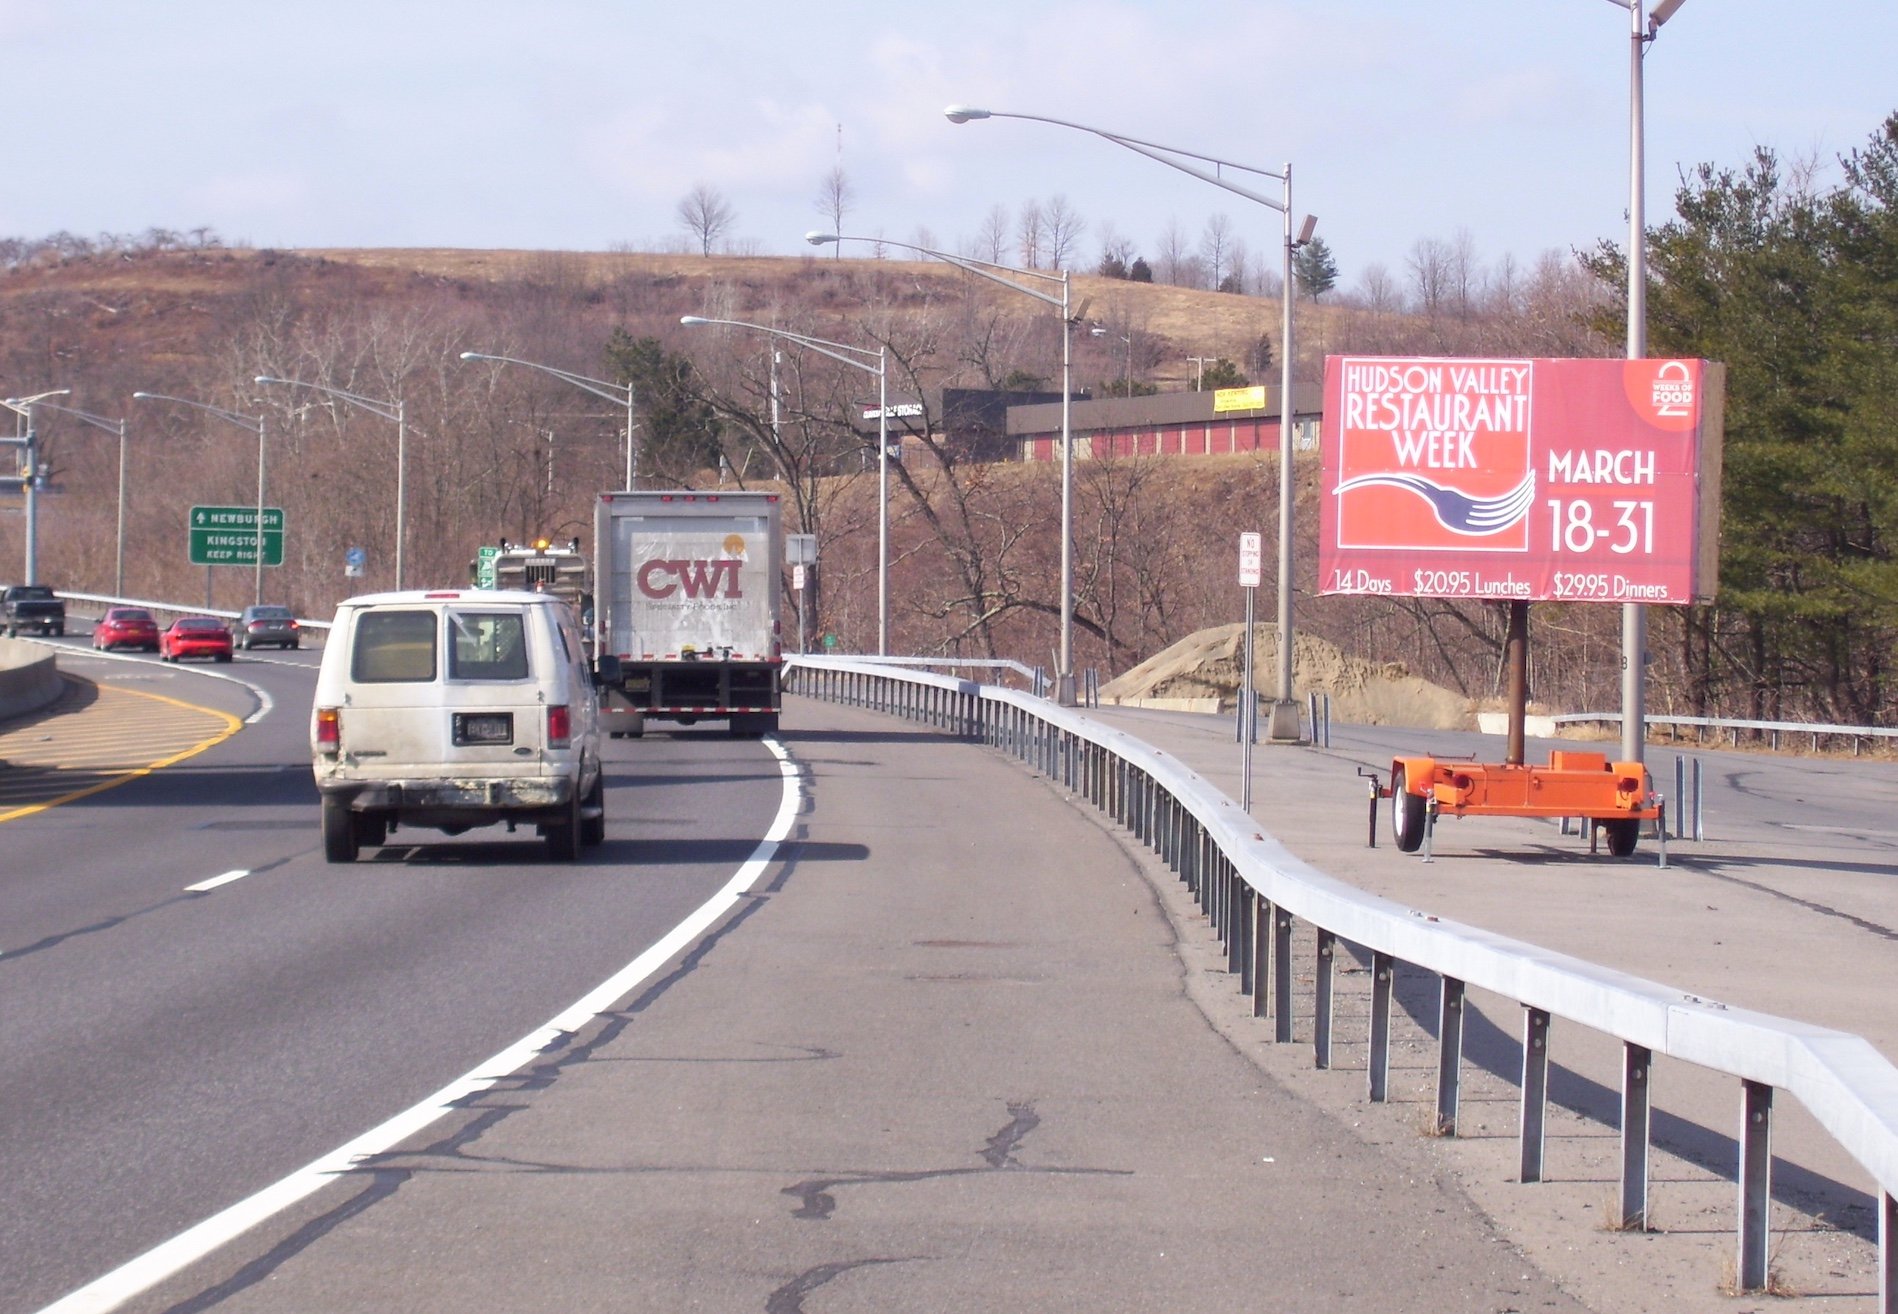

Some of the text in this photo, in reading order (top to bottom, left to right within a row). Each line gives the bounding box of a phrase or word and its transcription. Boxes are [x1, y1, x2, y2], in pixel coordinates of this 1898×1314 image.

[1348, 366, 1528, 395] HUDSON VALLEY
[1652, 383, 1692, 391] WEEKS OF
[1652, 391, 1692, 403] FOOD
[1346, 393, 1528, 432] RESTAURANT
[1391, 430, 1478, 468] WEEK
[1548, 449, 1655, 484] MARCH
[210, 513, 278, 525] NEWBURGH
[1547, 499, 1654, 553] 18-31
[206, 550, 233, 559] KEEP
[637, 559, 743, 599] CWI
[1334, 568, 1668, 598] 14 Days $20.95 Lunches $29.95 Dinners
